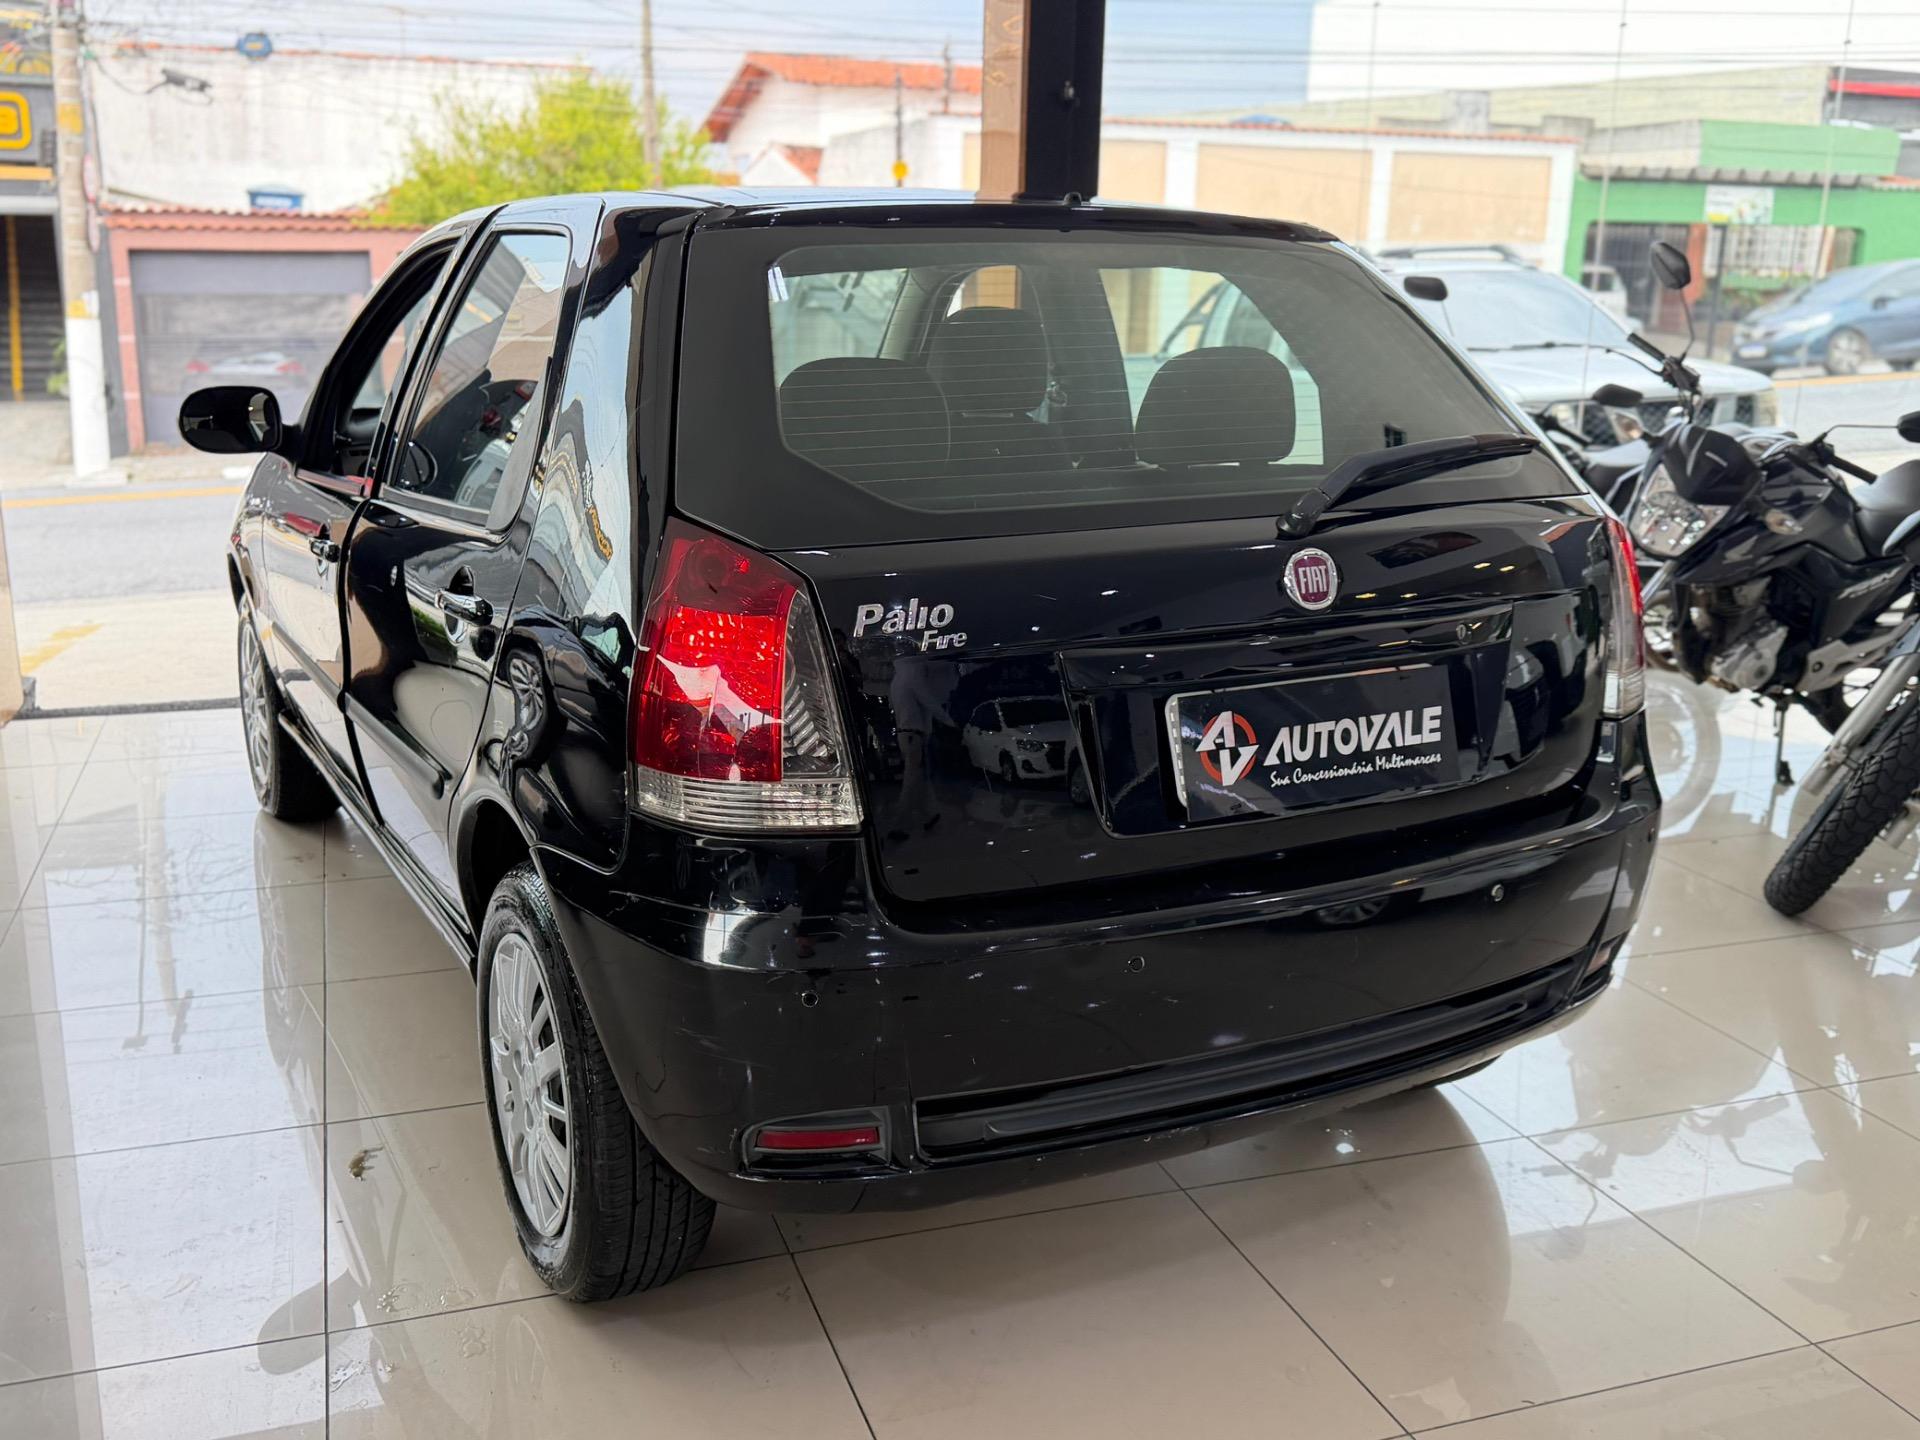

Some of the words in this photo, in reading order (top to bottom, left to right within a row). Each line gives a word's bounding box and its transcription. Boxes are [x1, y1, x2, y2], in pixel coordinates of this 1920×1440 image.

[1298, 565, 1327, 594] FIAT
[853, 598, 954, 638] Palio
[920, 629, 968, 652] Fire
[1263, 705, 1442, 767] AUTOVALE
[1270, 770, 1291, 788] Sua
[1293, 761, 1374, 784] Concessionária
[1375, 753, 1442, 771] Multimarcas
